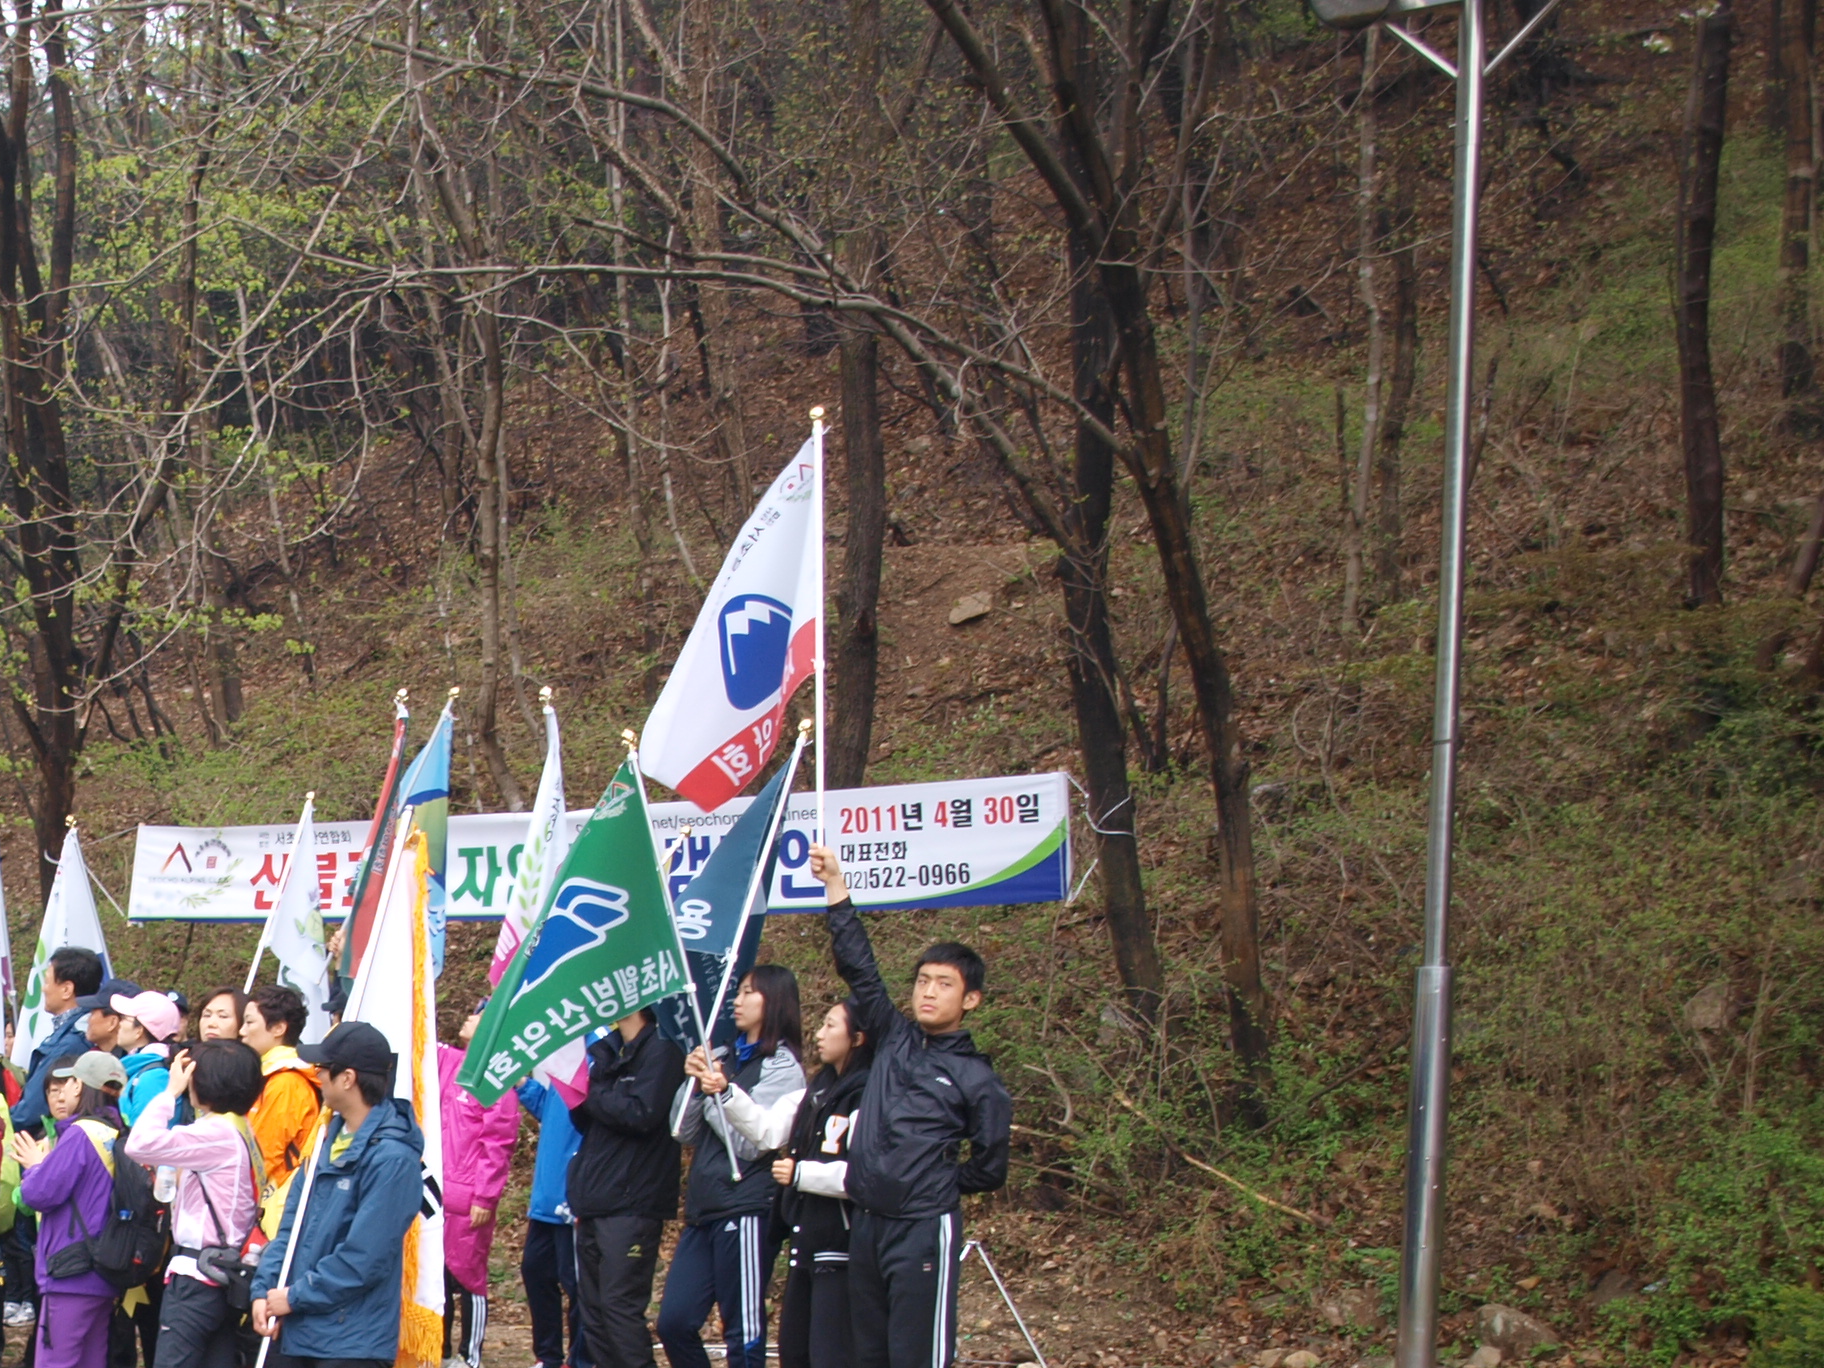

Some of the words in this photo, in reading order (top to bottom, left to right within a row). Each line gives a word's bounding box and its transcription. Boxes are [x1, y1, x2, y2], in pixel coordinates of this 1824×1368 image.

[839, 801, 924, 835] 2011년
[934, 798, 973, 829] 4월
[983, 793, 1040, 826] 30일
[839, 840, 908, 863] 대표전화
[840, 862, 971, 890] 02)522-0966
